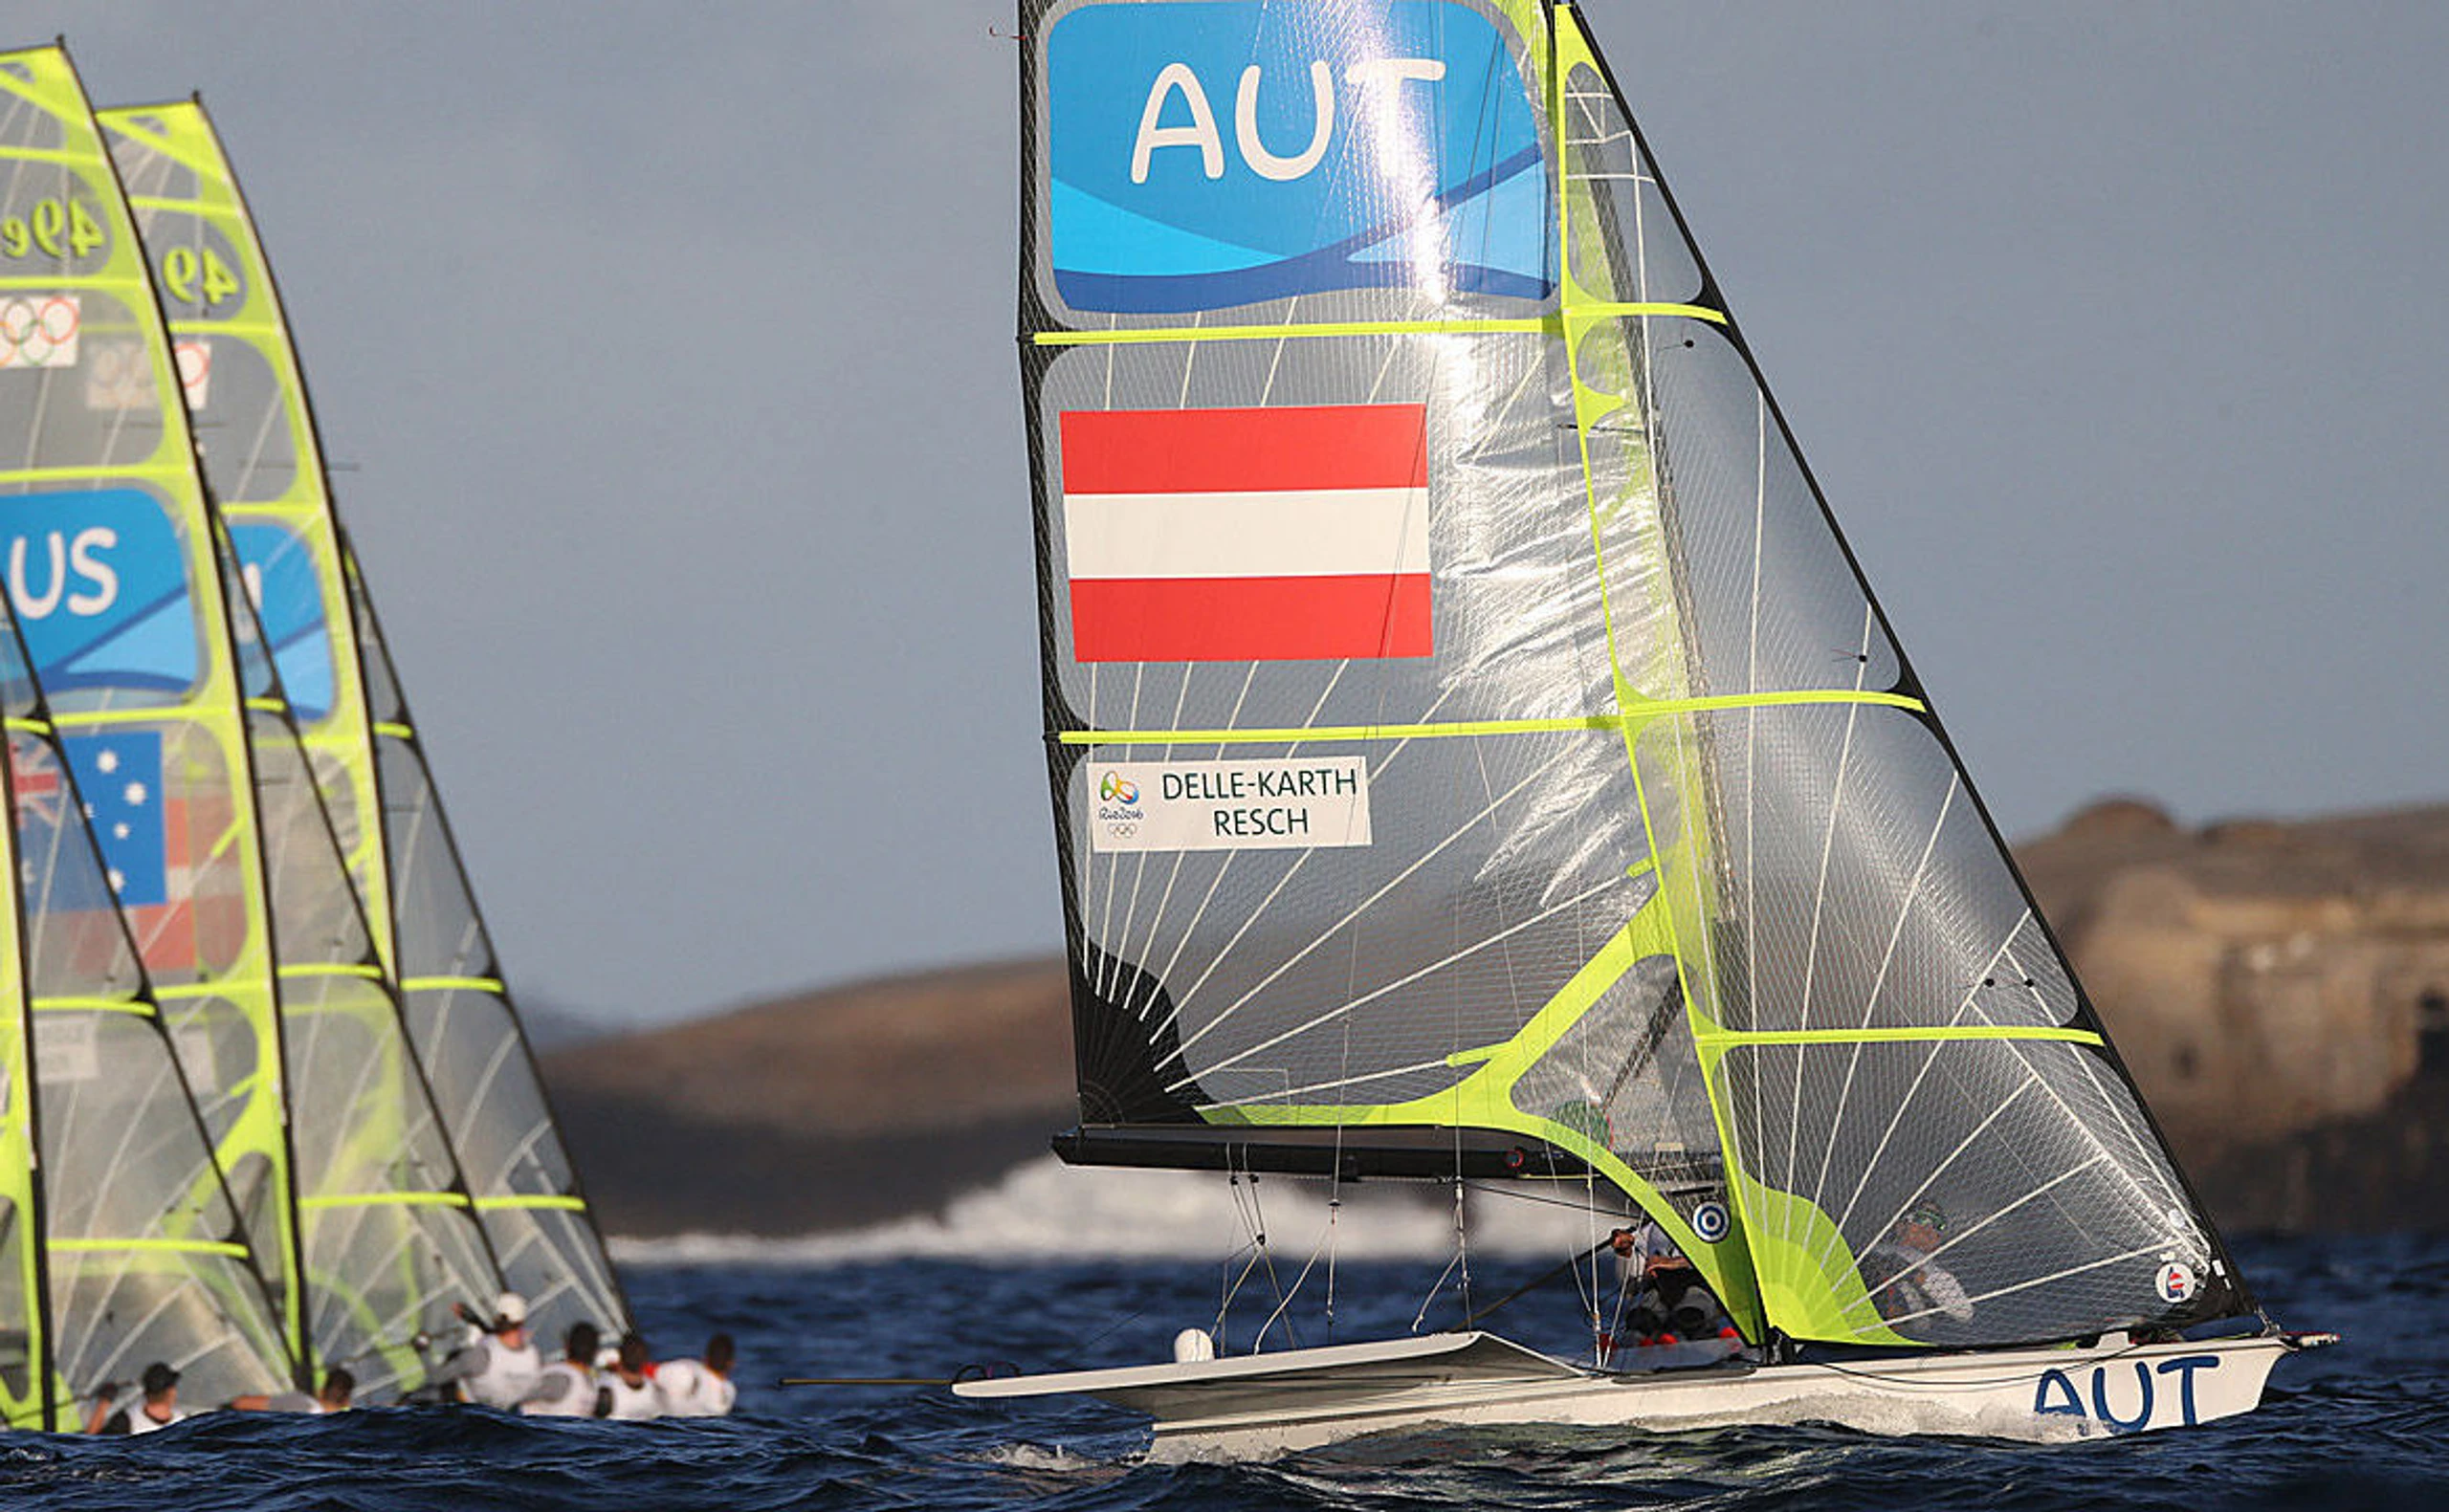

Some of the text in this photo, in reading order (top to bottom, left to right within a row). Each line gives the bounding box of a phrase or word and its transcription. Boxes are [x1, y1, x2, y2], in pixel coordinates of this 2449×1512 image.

[1131, 58, 1445, 184] AUT
[1162, 768, 1357, 800] DELLE-KARTH
[1213, 808, 1309, 837] RESCH
[2034, 1355, 2219, 1435] AUT
